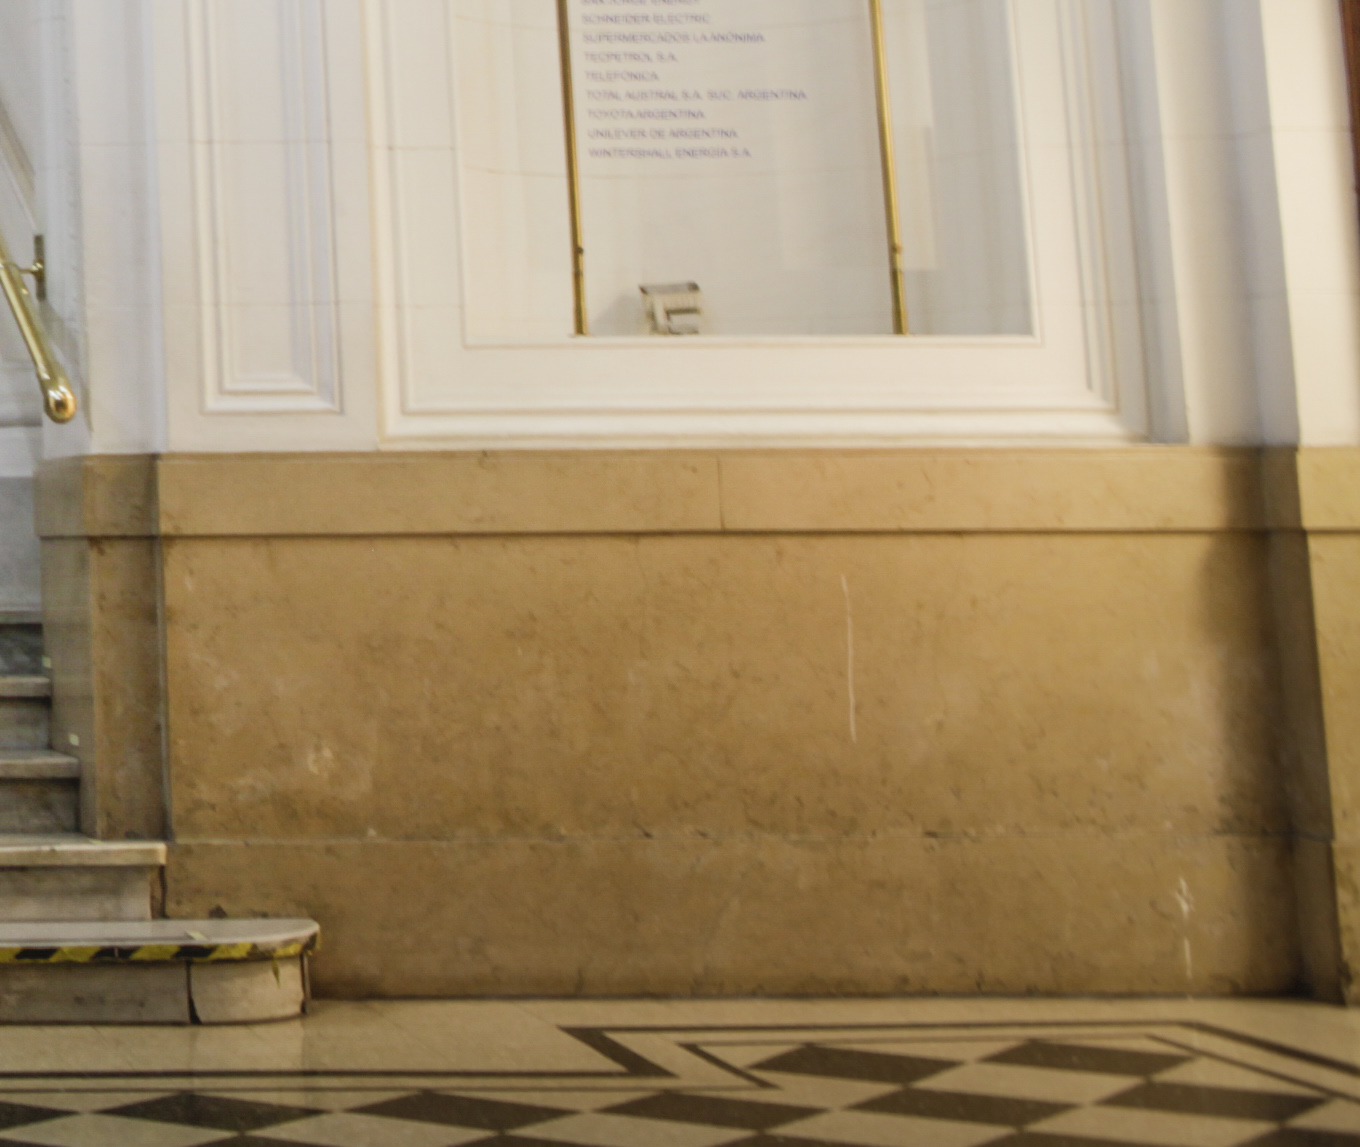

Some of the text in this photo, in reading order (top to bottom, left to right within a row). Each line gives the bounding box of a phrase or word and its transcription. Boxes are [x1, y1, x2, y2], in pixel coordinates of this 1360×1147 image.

[581, 13, 712, 24] SCHNEIDER ELECTRIC
[582, 32, 690, 43] SUPERMERCADOS
[584, 51, 654, 62] TECPETROL
[585, 90, 623, 100] TOTAL
[624, 90, 679, 100] AUSTRAL
[737, 89, 808, 100] ARGENTINA
[586, 109, 706, 120] TOYOTA ARGENTINA
[587, 128, 739, 139] UNILEVER DE ARGENTINA
